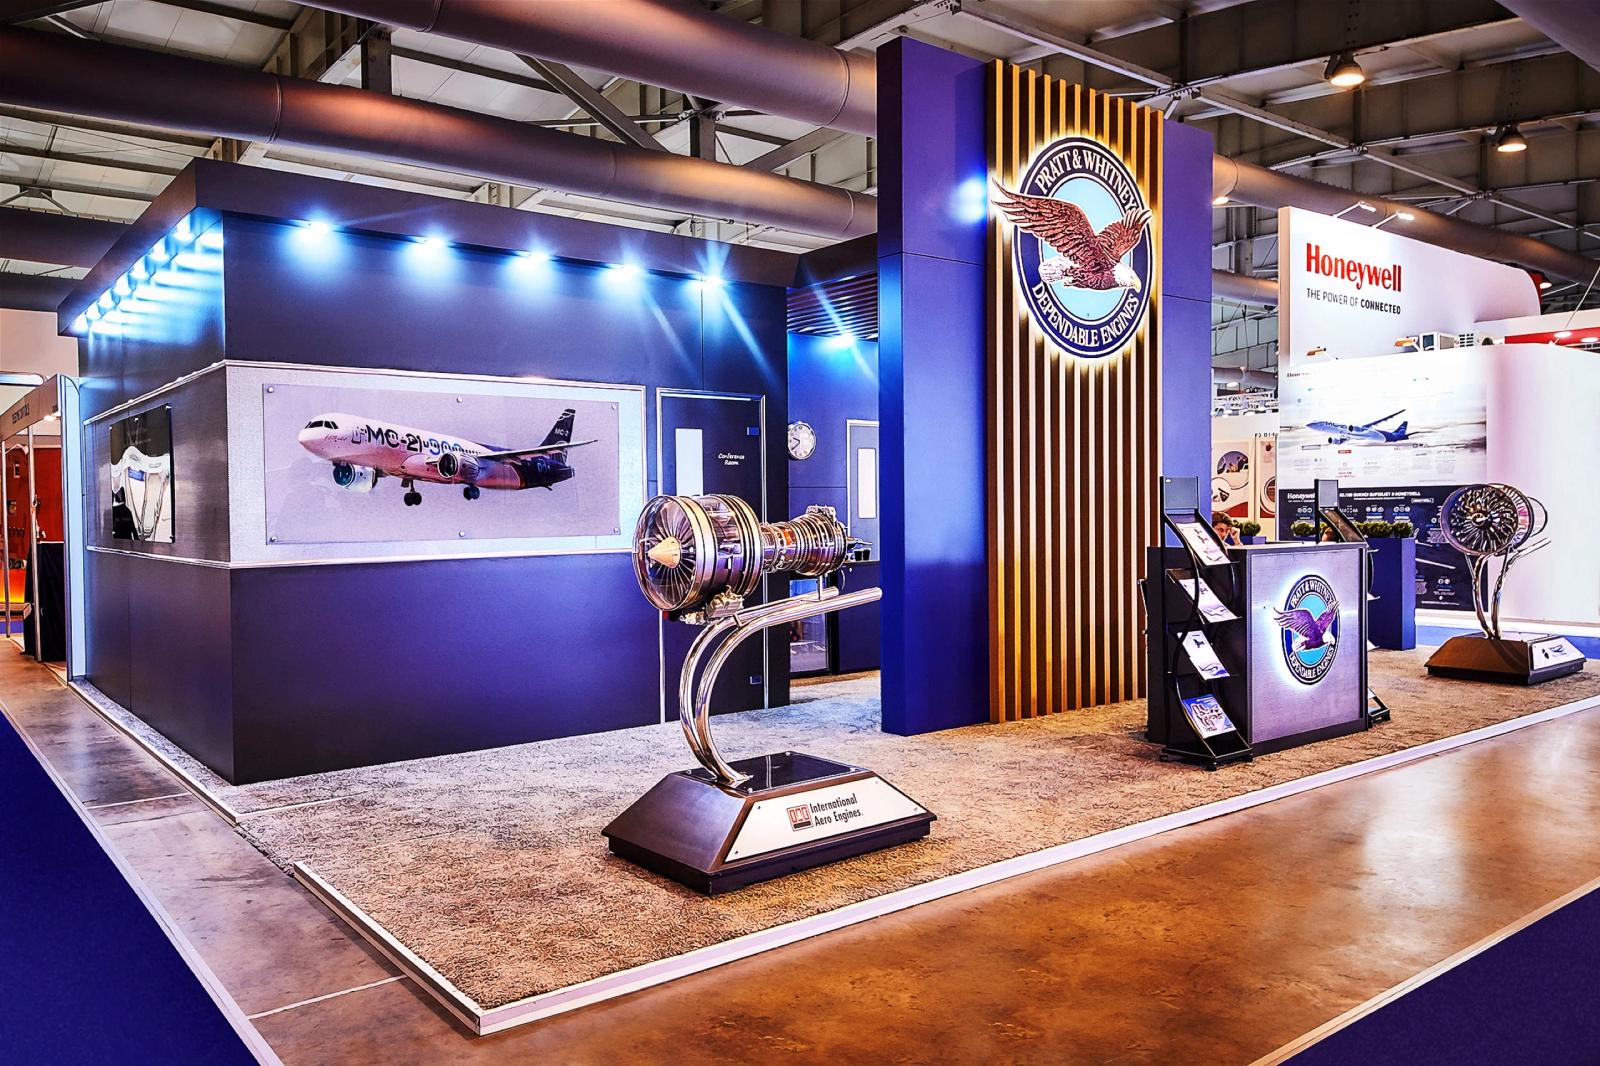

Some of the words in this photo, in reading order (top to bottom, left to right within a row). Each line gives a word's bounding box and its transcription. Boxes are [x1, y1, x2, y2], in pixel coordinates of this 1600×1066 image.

[1034, 150, 1071, 194] PRATT
[1072, 148, 1083, 170] &
[1082, 149, 1137, 210] WHITNEY
[1306, 242, 1402, 293] Honeywell
[1032, 283, 1100, 347] DEPENDABLE
[1101, 293, 1140, 345] ENGINES
[1306, 287, 1321, 301] THE
[1323, 290, 1348, 305] POWER
[1350, 295, 1359, 307] OF
[1360, 298, 1401, 315] CONNECTED
[718, 452, 745, 460] Conference
[810, 793, 858, 813] International
[814, 815, 832, 827] Aero
